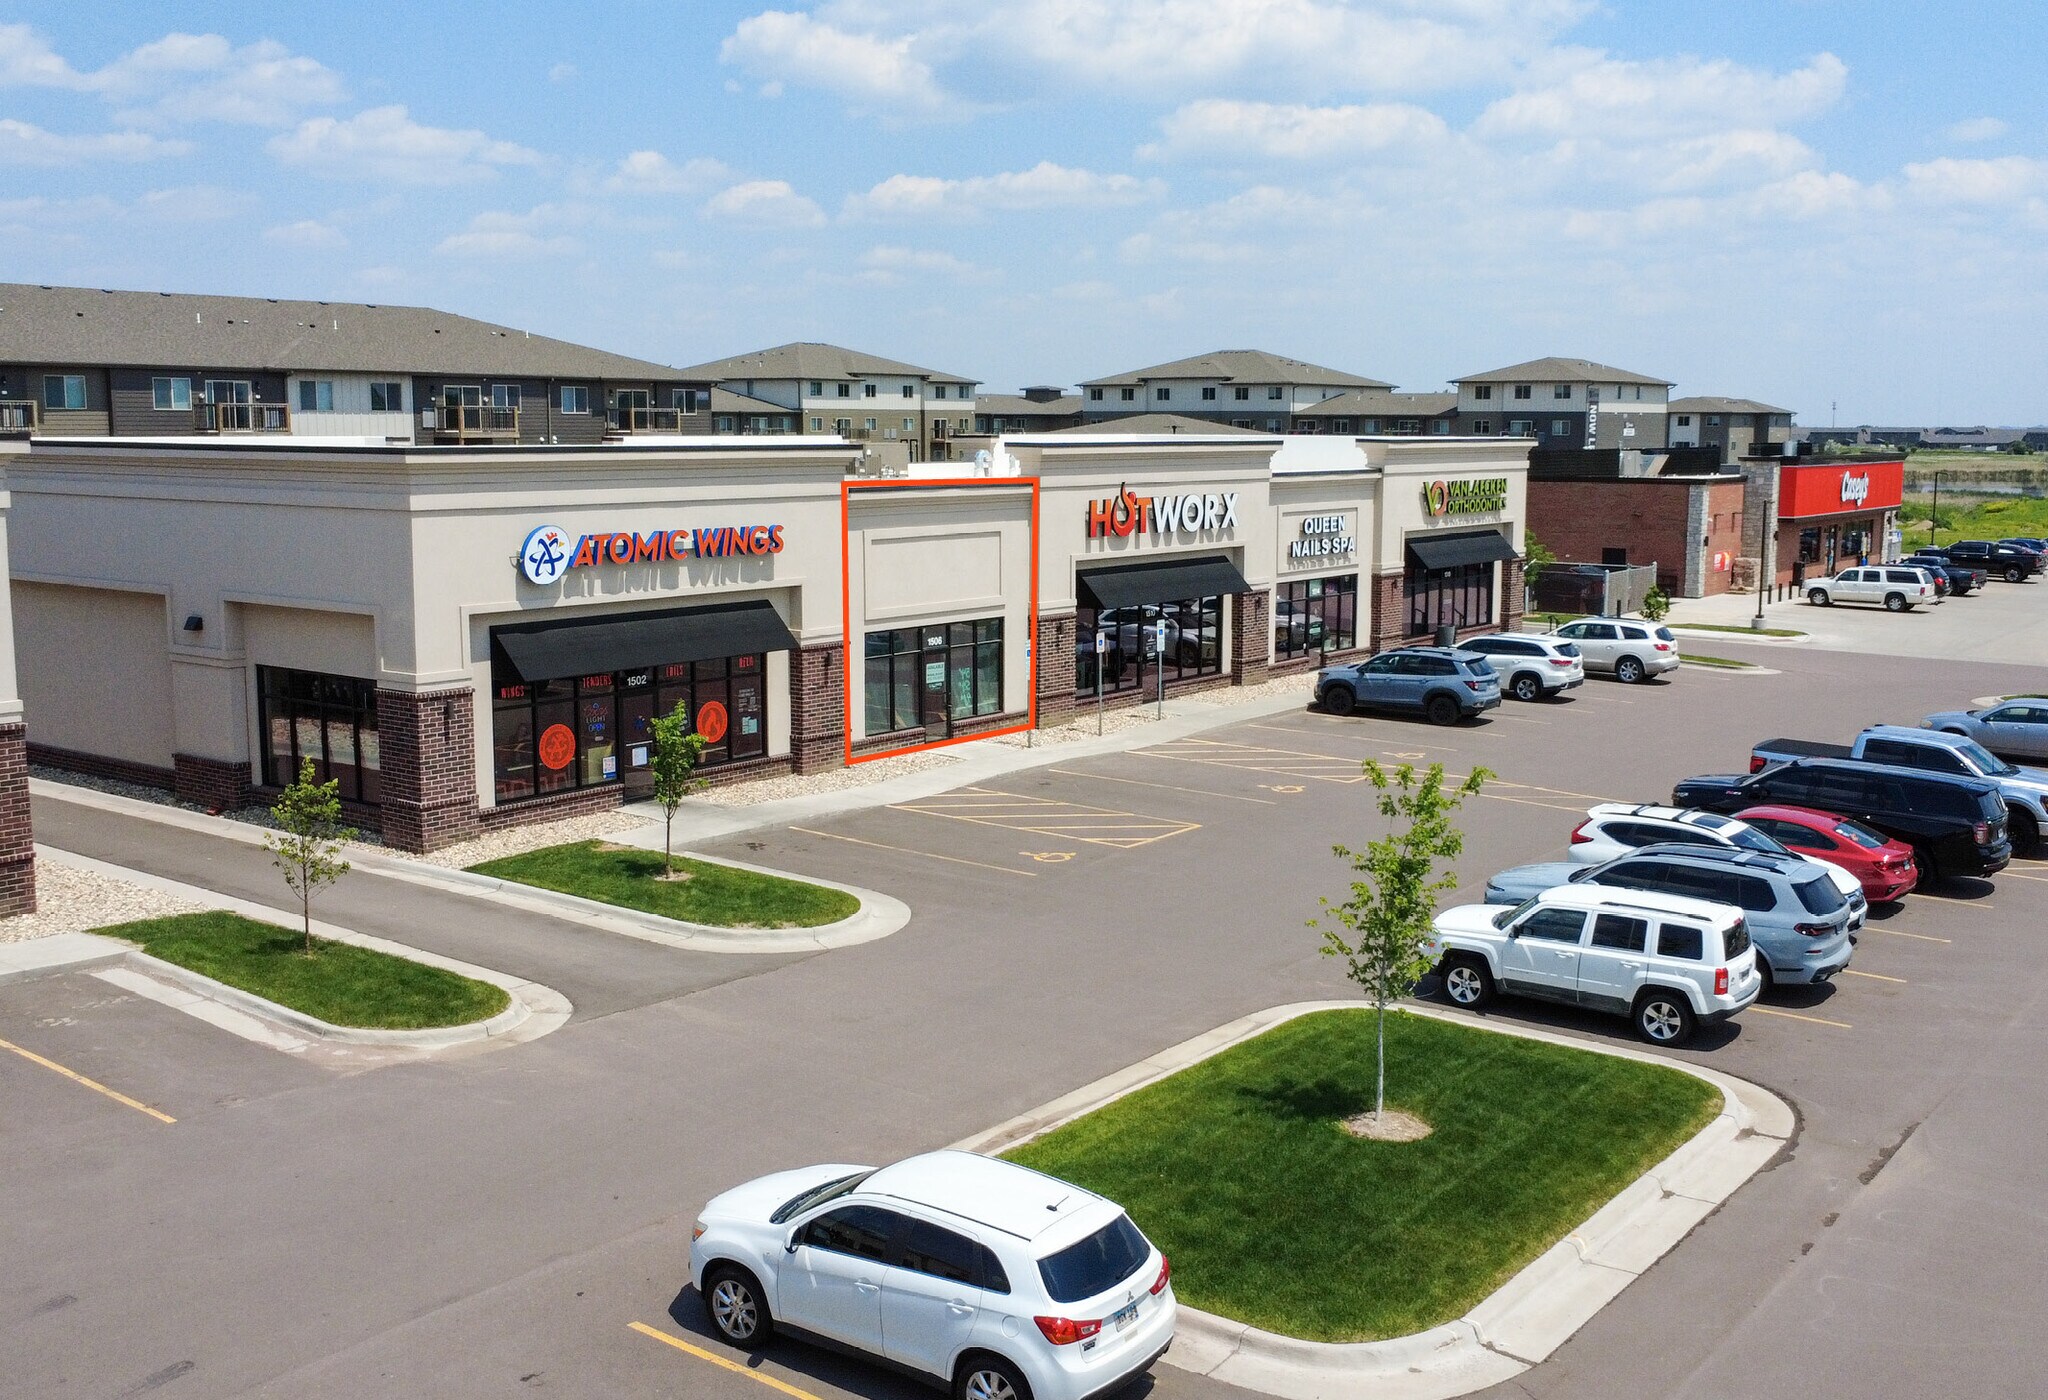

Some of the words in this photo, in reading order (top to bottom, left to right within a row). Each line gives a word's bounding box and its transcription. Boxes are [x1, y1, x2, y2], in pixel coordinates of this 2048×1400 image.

[1589, 404, 1598, 435] NOW
[1447, 478, 1507, 497] VANLAECKEN
[1841, 470, 1869, 507] Casey's
[1088, 482, 1239, 538] HOTWORX
[1447, 497, 1507, 515] ORTHODONTICS
[1303, 516, 1345, 534] QUEEN
[571, 529, 689, 568] ATOMIC
[693, 525, 784, 558] WINGS
[1291, 539, 1330, 557] NAILS
[1331, 537, 1355, 554] SPA
[583, 674, 612, 688] TENDERS
[626, 674, 647, 687] 1502
[501, 685, 525, 698] WINGS
